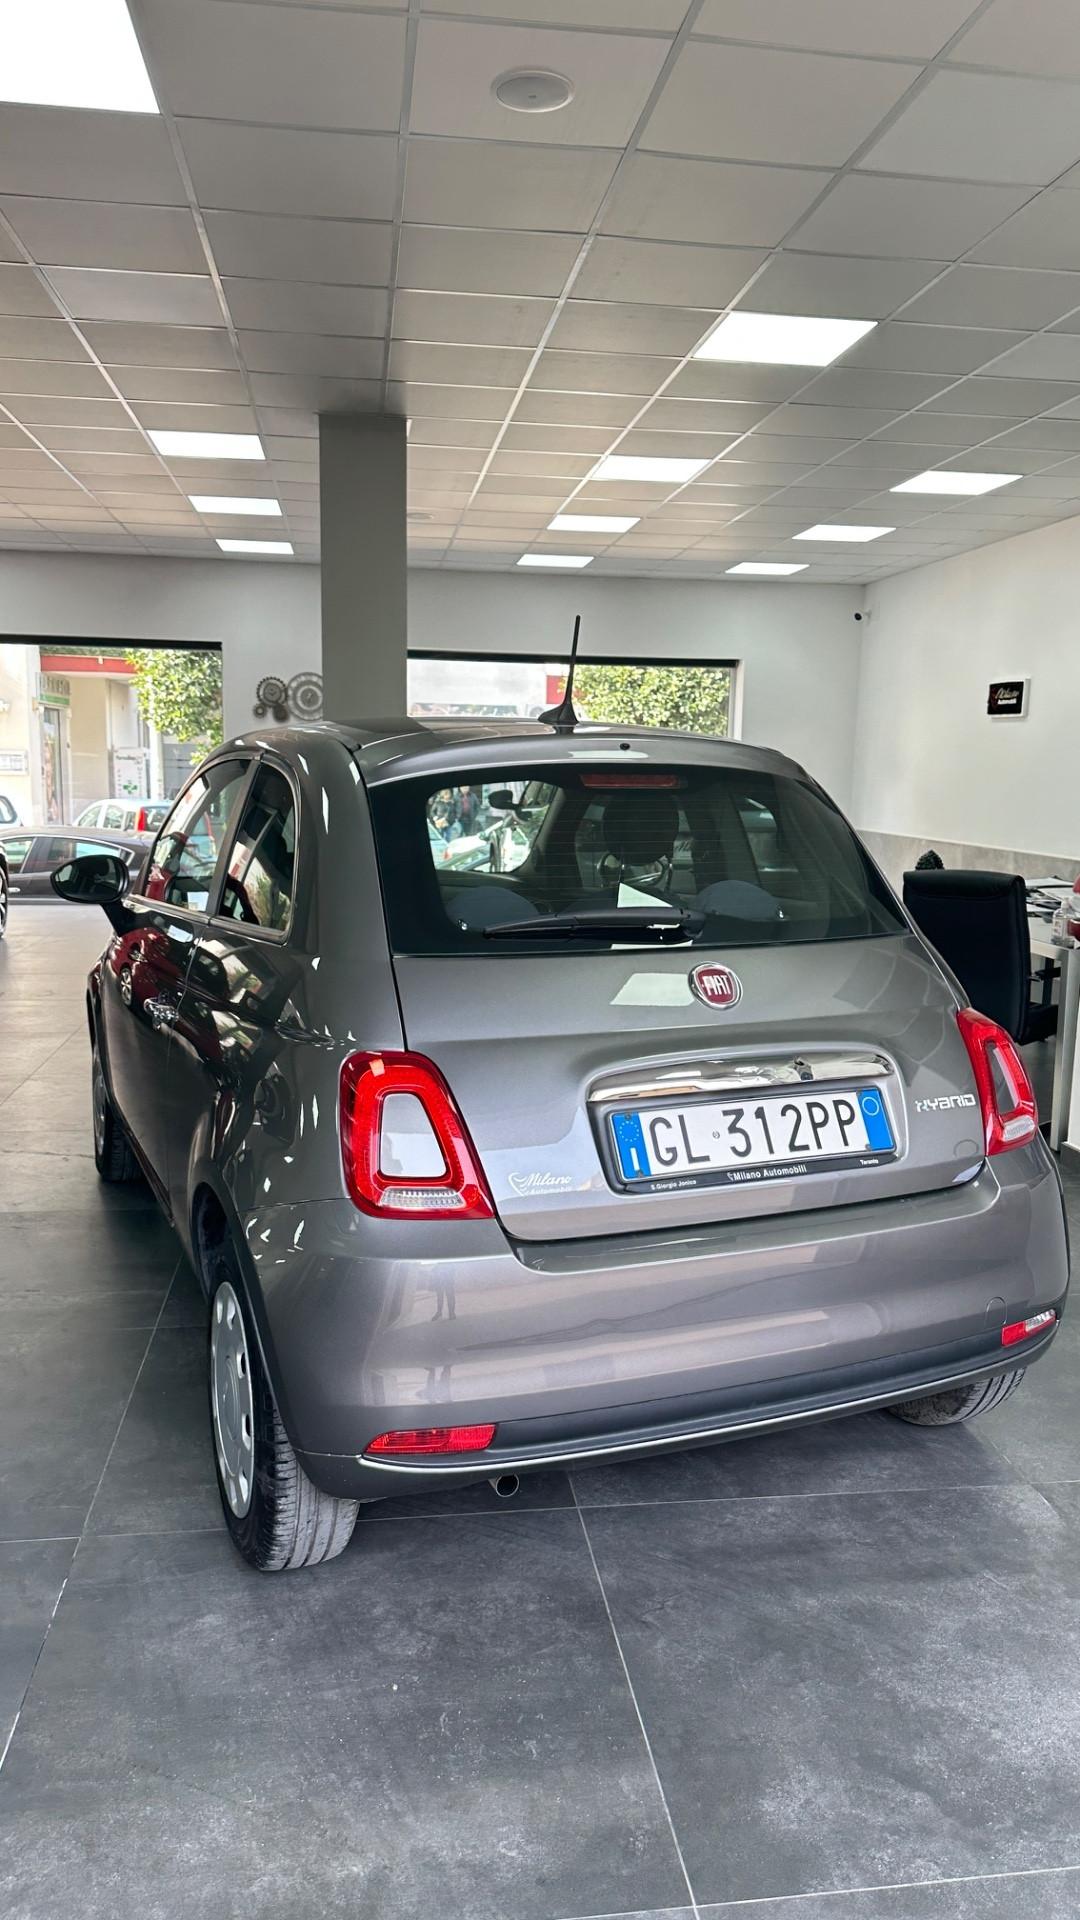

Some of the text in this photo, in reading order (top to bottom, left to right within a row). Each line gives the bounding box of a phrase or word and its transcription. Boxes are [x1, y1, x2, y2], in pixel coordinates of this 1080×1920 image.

[702, 975, 731, 996] FIAT
[914, 1093, 976, 1112] HYBRID
[649, 1099, 855, 1167] GL 312PP
[527, 1172, 572, 1186] Milano
[733, 1164, 807, 1181] Milano Automobili
